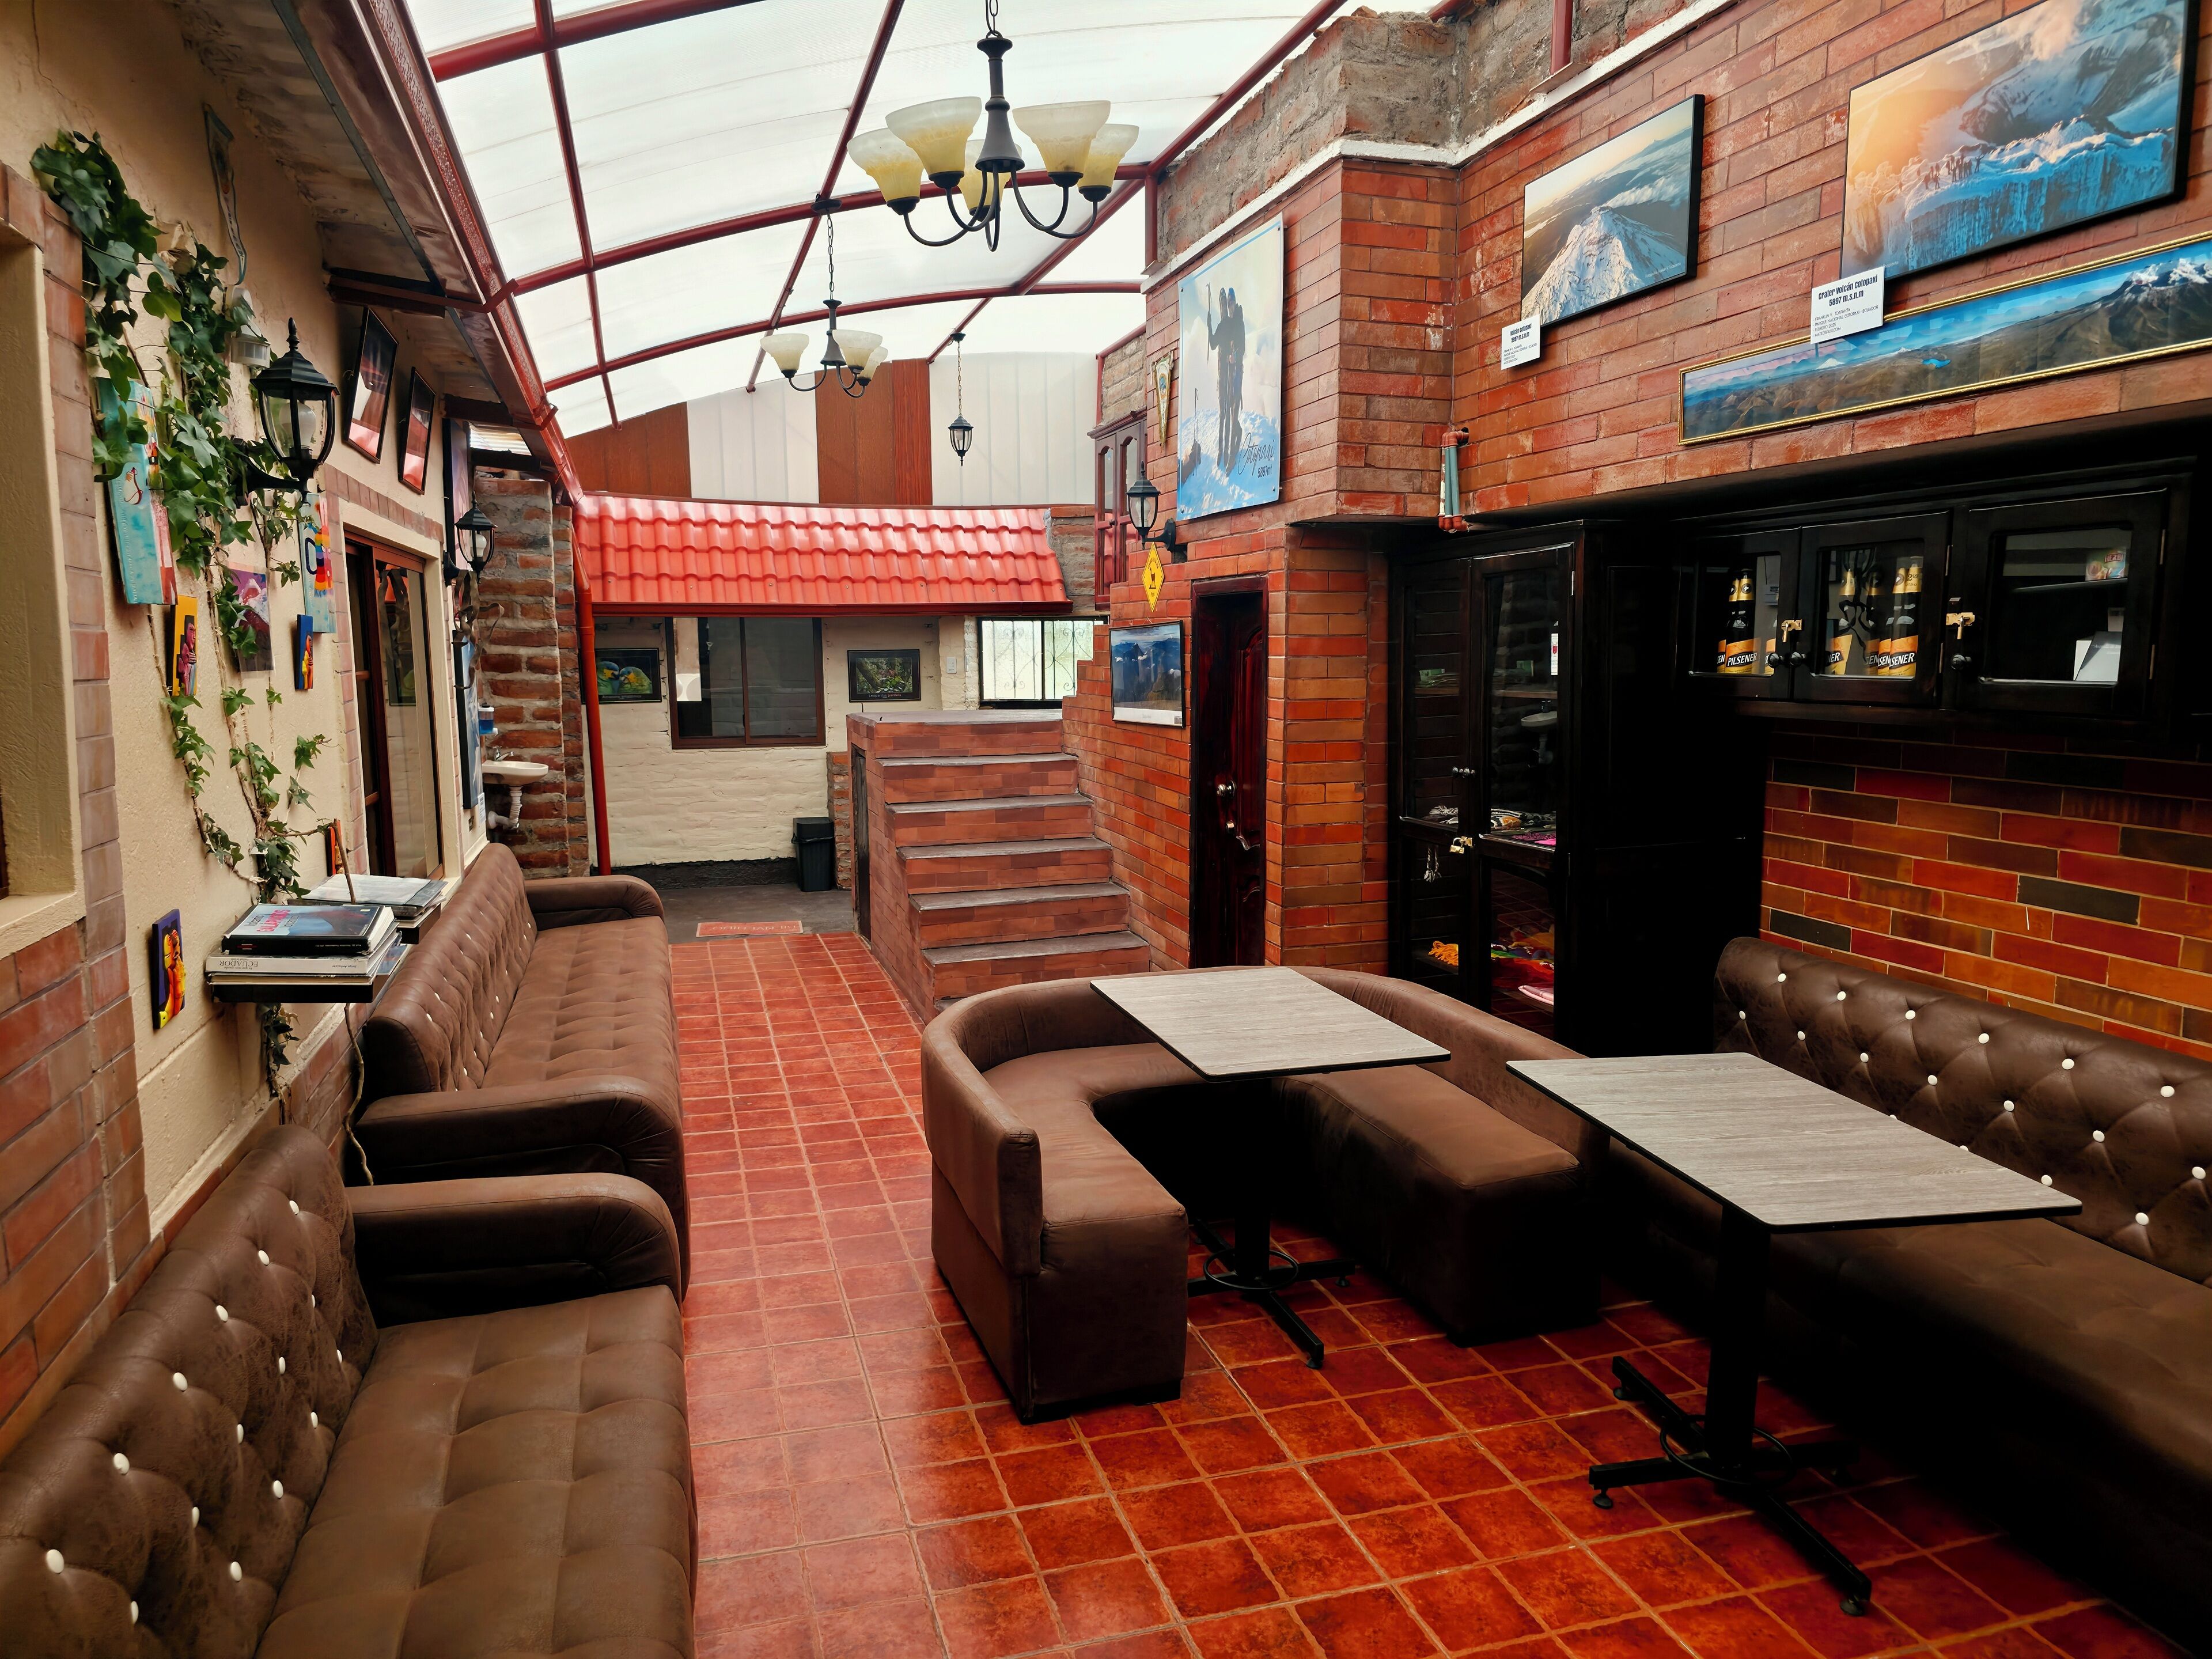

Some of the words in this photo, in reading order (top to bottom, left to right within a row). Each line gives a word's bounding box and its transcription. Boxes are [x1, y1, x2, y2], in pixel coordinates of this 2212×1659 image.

[1836, 282, 1853, 294] Volcán
[1854, 274, 1878, 289] Cotopaxi
[1829, 296, 1842, 306] 5897
[1843, 290, 1864, 302] m.s.n.m
[1844, 310, 1860, 318] COTOPAXI
[1862, 305, 1878, 313] ECUADOR
[1238, 432, 1275, 476] Cotopaxi
[1257, 464, 1272, 478] 5897mt
[1727, 652, 1758, 666] PILSENER
